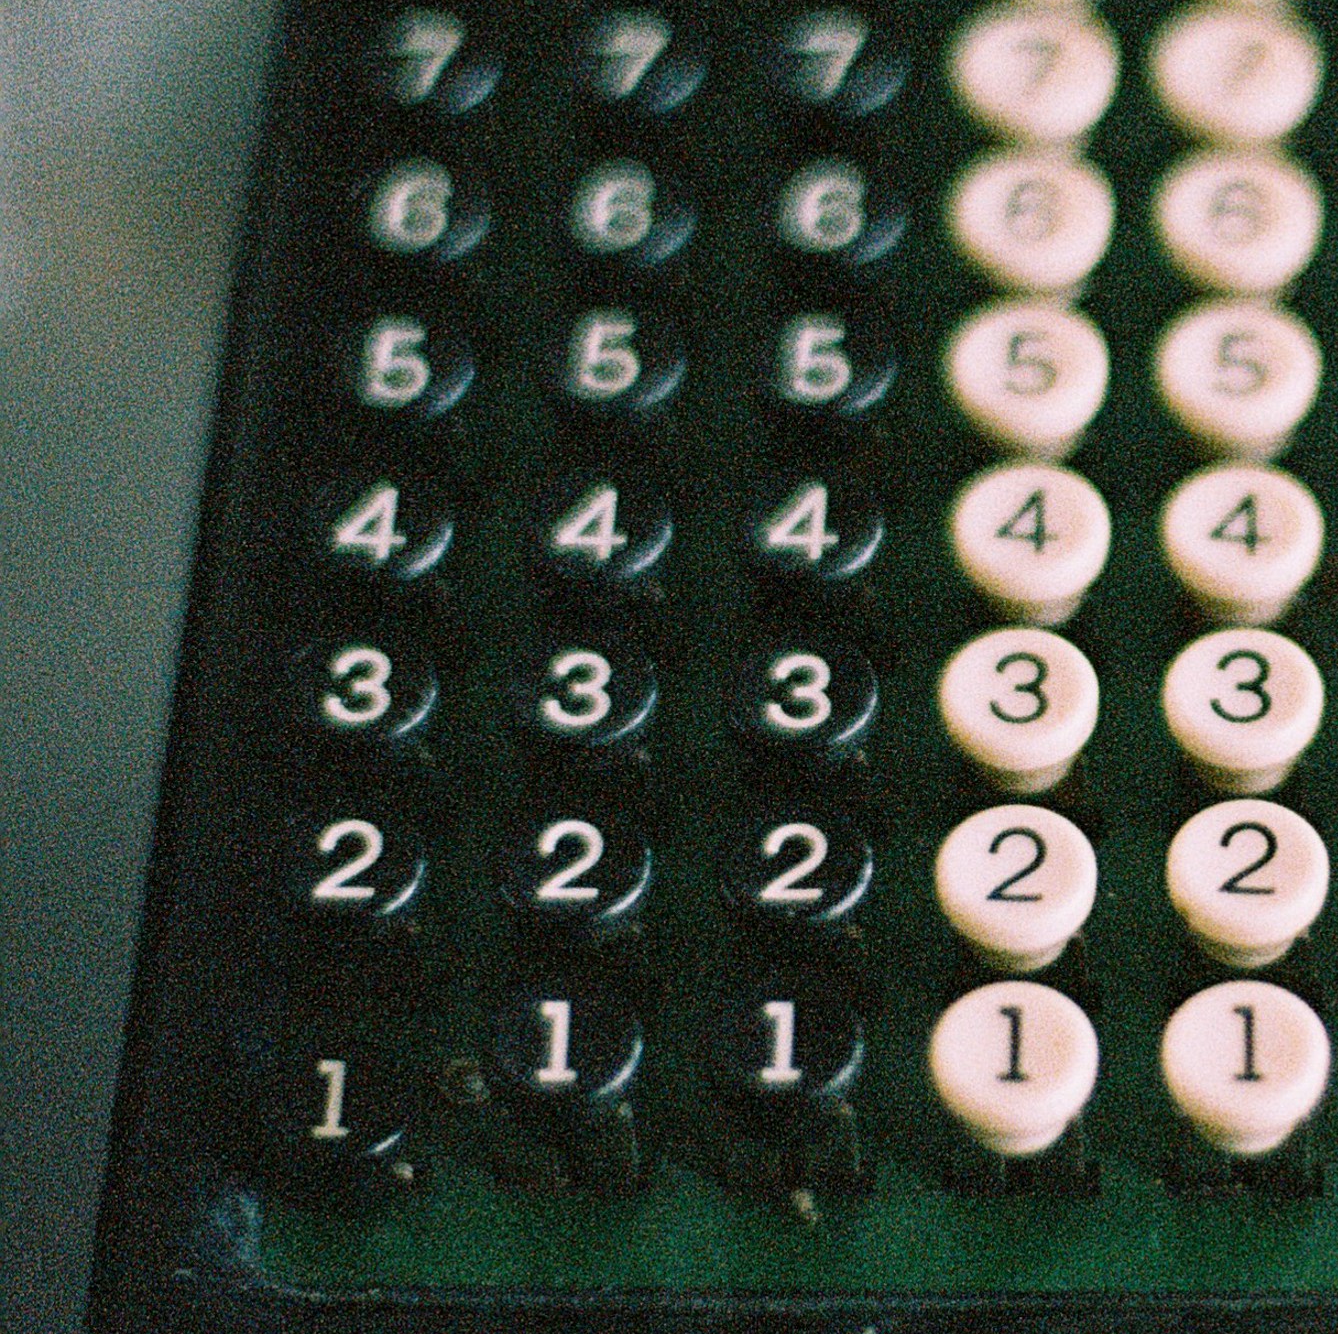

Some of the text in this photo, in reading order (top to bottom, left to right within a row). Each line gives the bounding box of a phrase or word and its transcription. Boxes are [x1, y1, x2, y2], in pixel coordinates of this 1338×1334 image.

[372, 159, 450, 253] 6
[572, 161, 654, 252] 6
[781, 161, 863, 252] 6
[365, 320, 430, 408] 5
[572, 315, 639, 398] 5
[781, 315, 850, 401] 5
[1002, 331, 1059, 397] 5
[1213, 331, 1270, 397] 5
[333, 483, 405, 564] 4
[553, 486, 625, 562] 4
[767, 486, 838, 562] 4
[996, 491, 1054, 552] 4
[1209, 493, 1269, 553] 4
[322, 647, 392, 726] 3
[541, 650, 611, 729] 3
[766, 651, 832, 731] 3
[987, 650, 1050, 726] 3
[1206, 650, 1270, 726] 3
[312, 819, 383, 900] 2
[536, 819, 603, 901] 2
[760, 822, 828, 903] 2
[984, 826, 1048, 901] 2
[1216, 820, 1281, 896] 2
[536, 1000, 577, 1083] 1
[762, 1000, 802, 1083] 1
[995, 1005, 1034, 1083] 1
[1230, 1005, 1273, 1083] 1
[312, 1059, 348, 1137] 1
